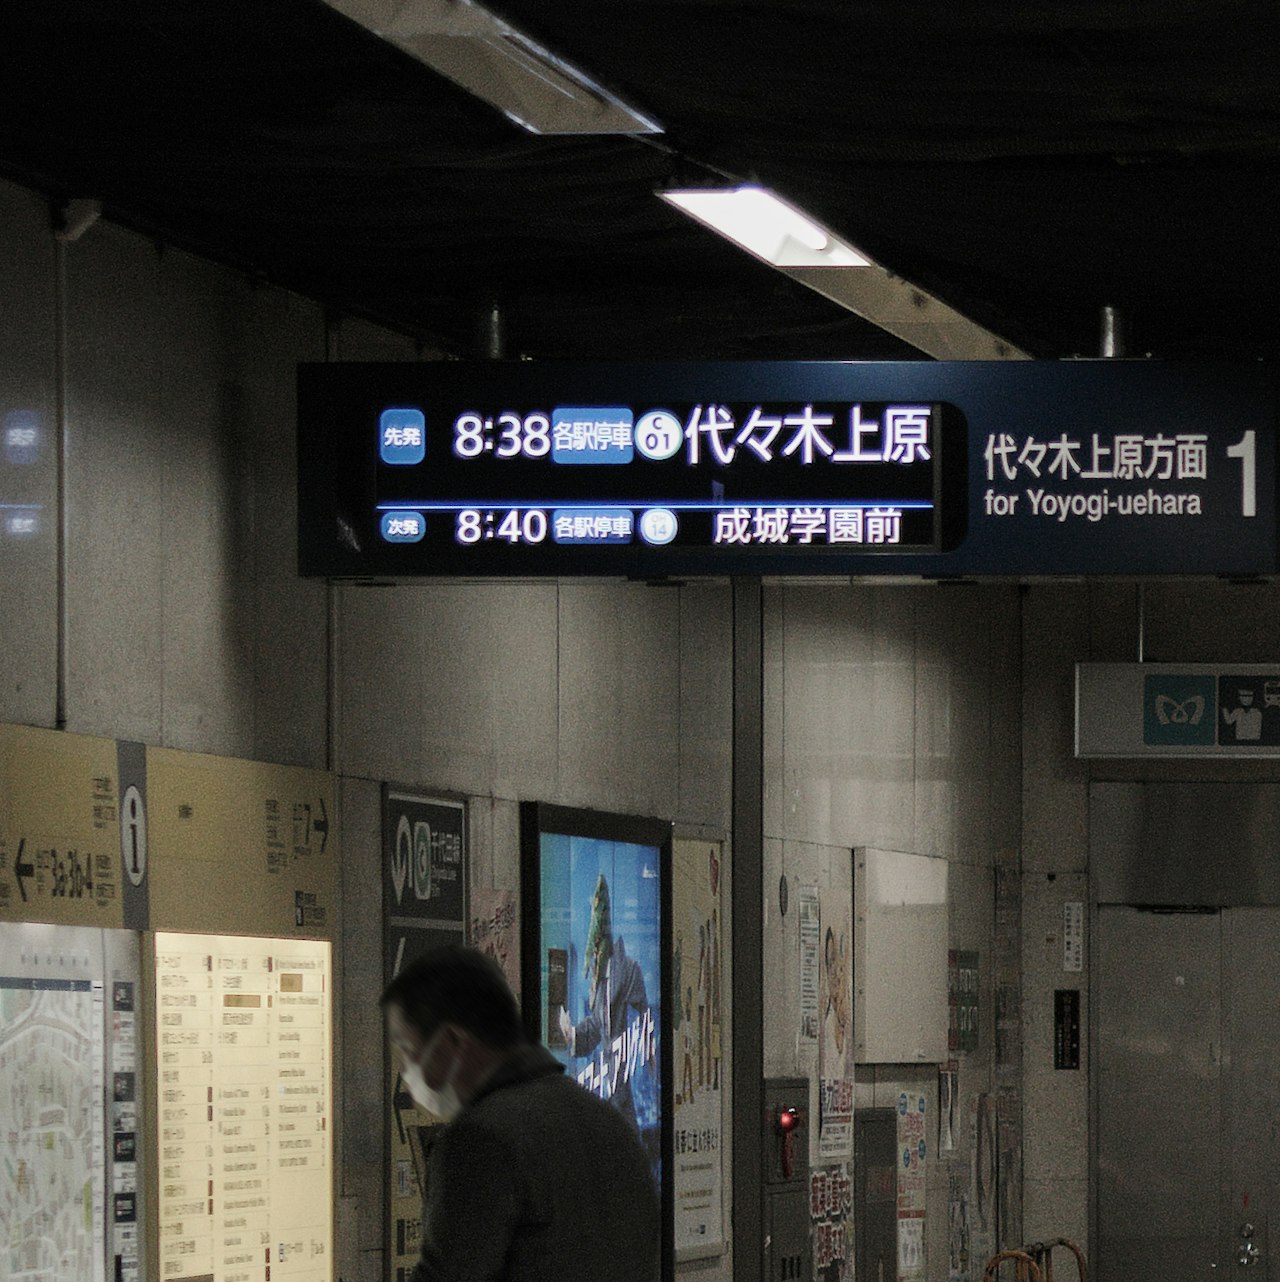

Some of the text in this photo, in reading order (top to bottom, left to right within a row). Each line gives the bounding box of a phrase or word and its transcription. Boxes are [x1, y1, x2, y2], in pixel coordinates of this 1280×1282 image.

[384, 413, 632, 457] 先発 8:38 各駅停車
[645, 433, 671, 450] 01
[685, 404, 931, 465] 代々木上原
[984, 434, 1208, 480] 代々木上原方面
[1227, 430, 1256, 517] 1
[715, 507, 902, 544] 成城学園前
[985, 489, 1202, 522] for Yoyogi-uehara
[387, 510, 631, 543] 次発 8:40 各駅停車
